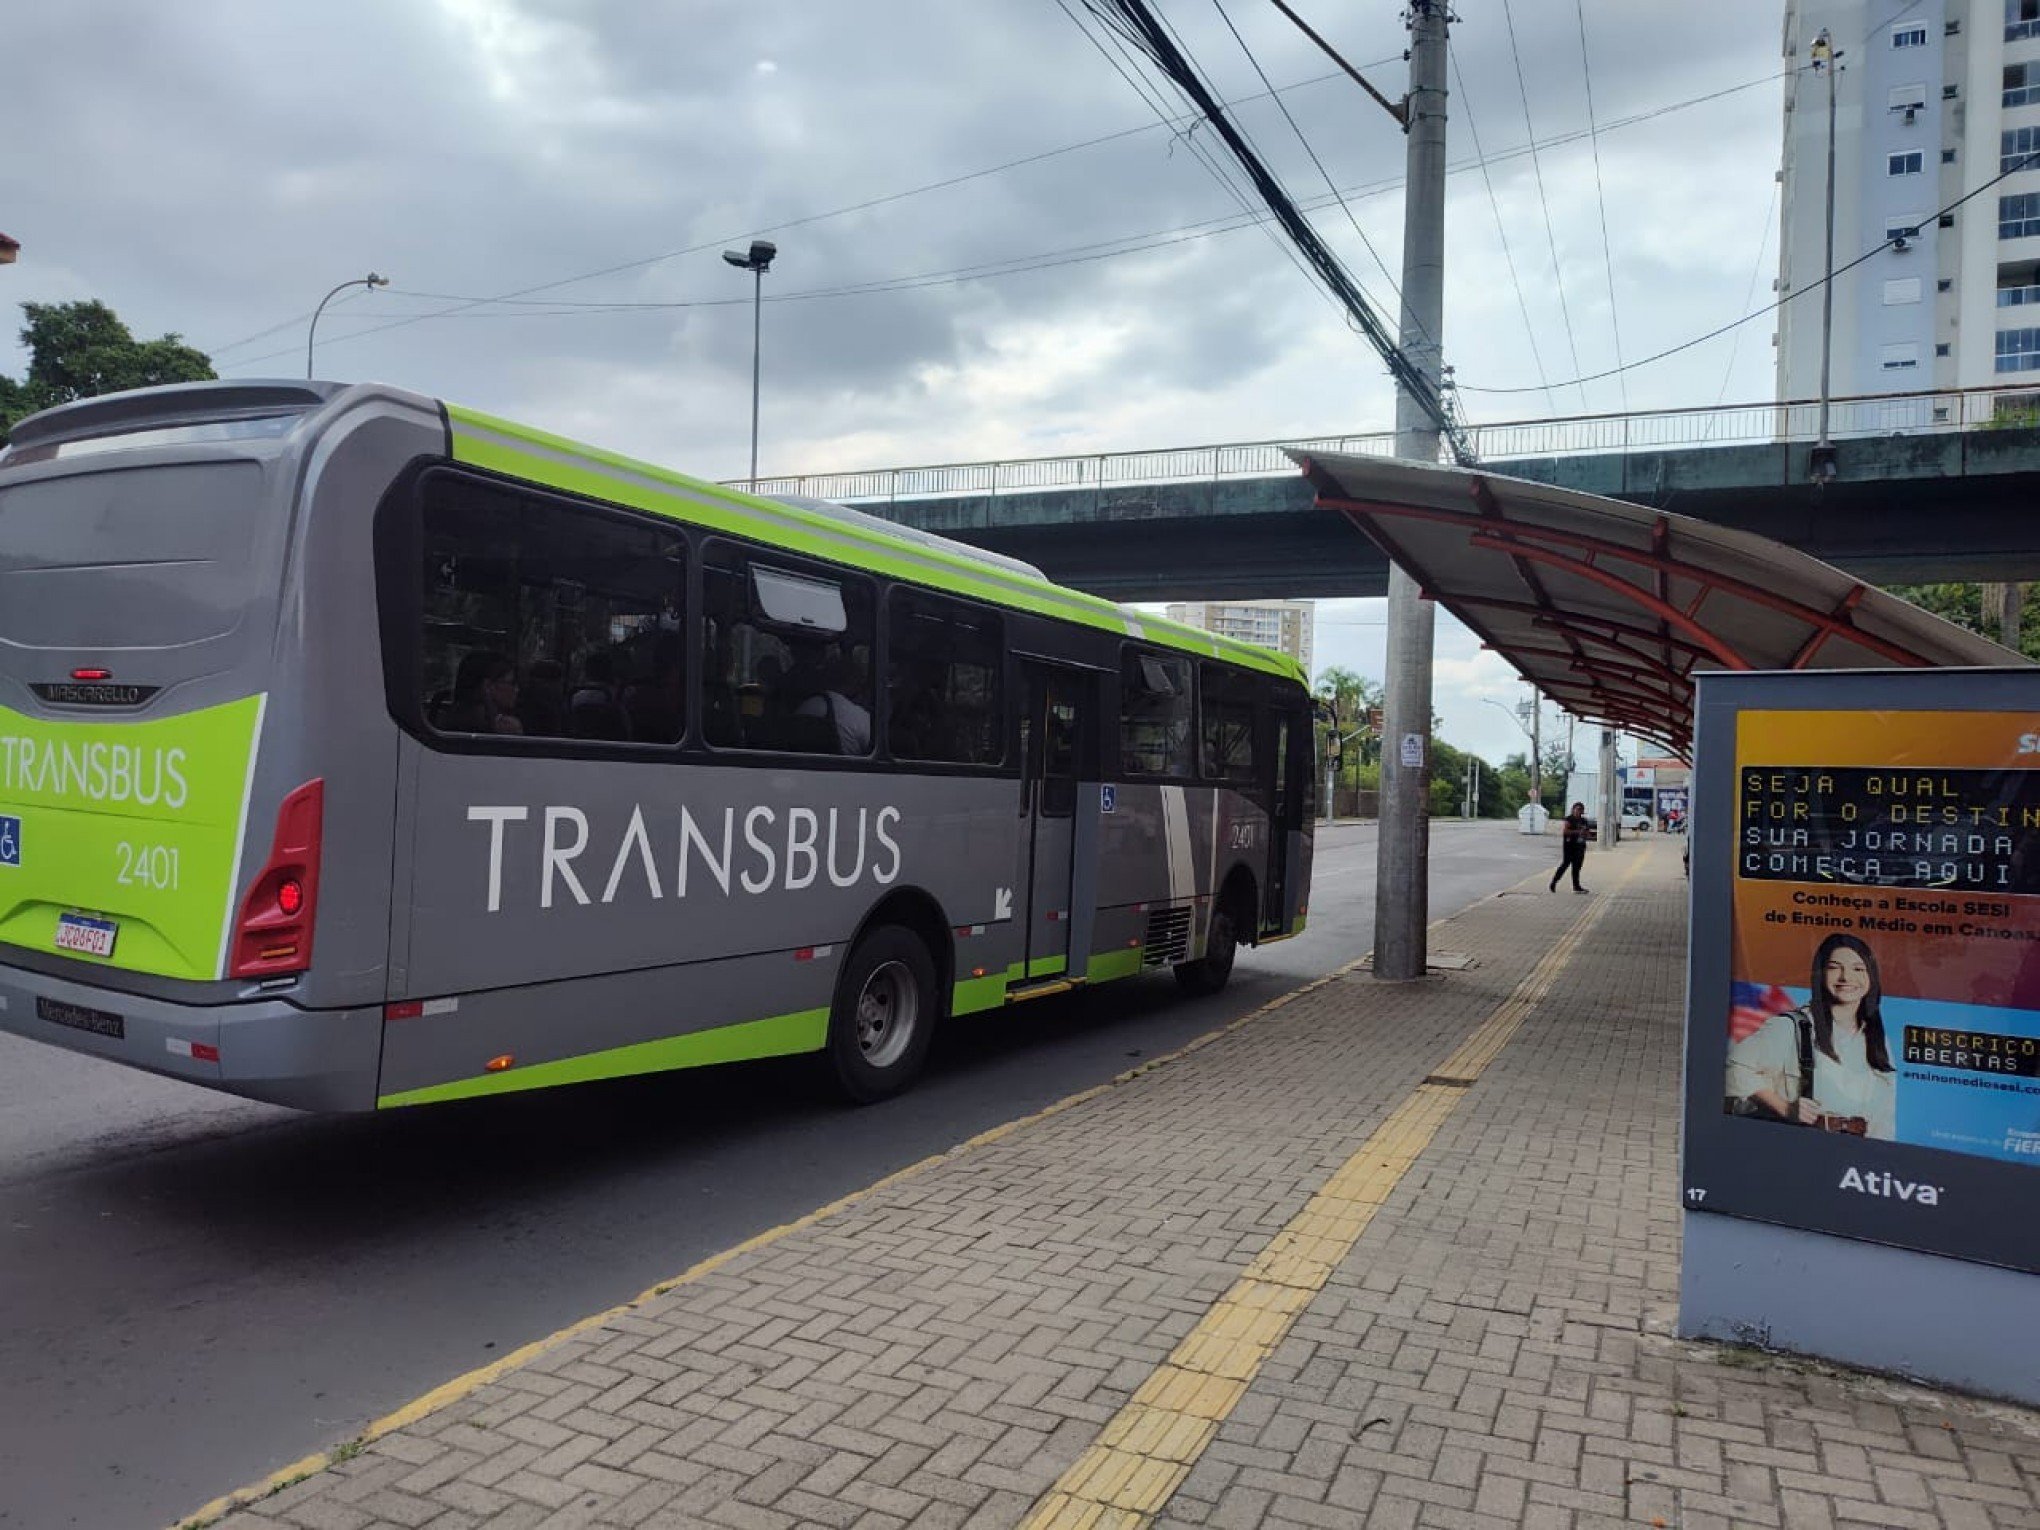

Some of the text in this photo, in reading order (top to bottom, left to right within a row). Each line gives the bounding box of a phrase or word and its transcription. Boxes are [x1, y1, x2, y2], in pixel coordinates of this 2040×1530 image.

[0, 736, 188, 809] TRANSBUS
[1748, 775, 1959, 797] SEJA QUAL
[1747, 801, 2040, 828] FOR O DESTIN
[1746, 827, 2013, 855] SUA JORNADA
[116, 840, 180, 890] 2401
[466, 803, 902, 912] TRANSBUS
[1915, 861, 2010, 884] AQUI
[1793, 891, 2011, 917] Conheça a Escola SESI
[1765, 910, 1787, 923] de
[1792, 911, 1853, 928] Ensino
[1859, 915, 1917, 932] Médio
[1923, 924, 1952, 935] em
[1908, 1047, 2017, 1070] ABERTAS
[1687, 1187, 1707, 1202] 17
[1839, 1166, 1938, 1206] Ativa
